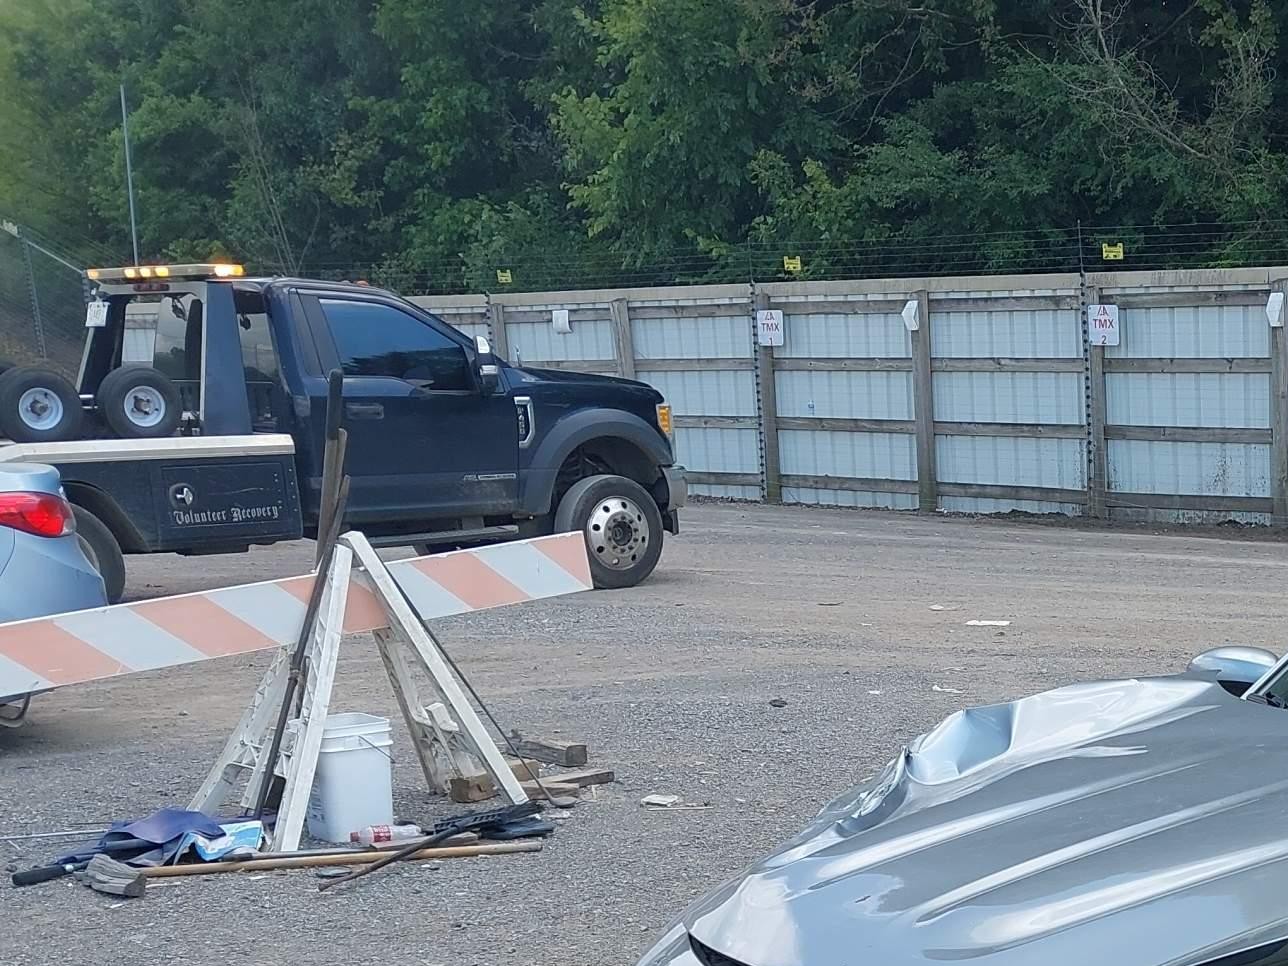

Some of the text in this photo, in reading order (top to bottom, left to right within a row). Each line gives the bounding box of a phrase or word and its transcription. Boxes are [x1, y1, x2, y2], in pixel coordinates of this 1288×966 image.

[760, 322, 780, 332] TMX
[1092, 318, 1115, 329] TMX
[1101, 334, 1107, 345] 2
[173, 505, 280, 525] Volunteer Recovery
